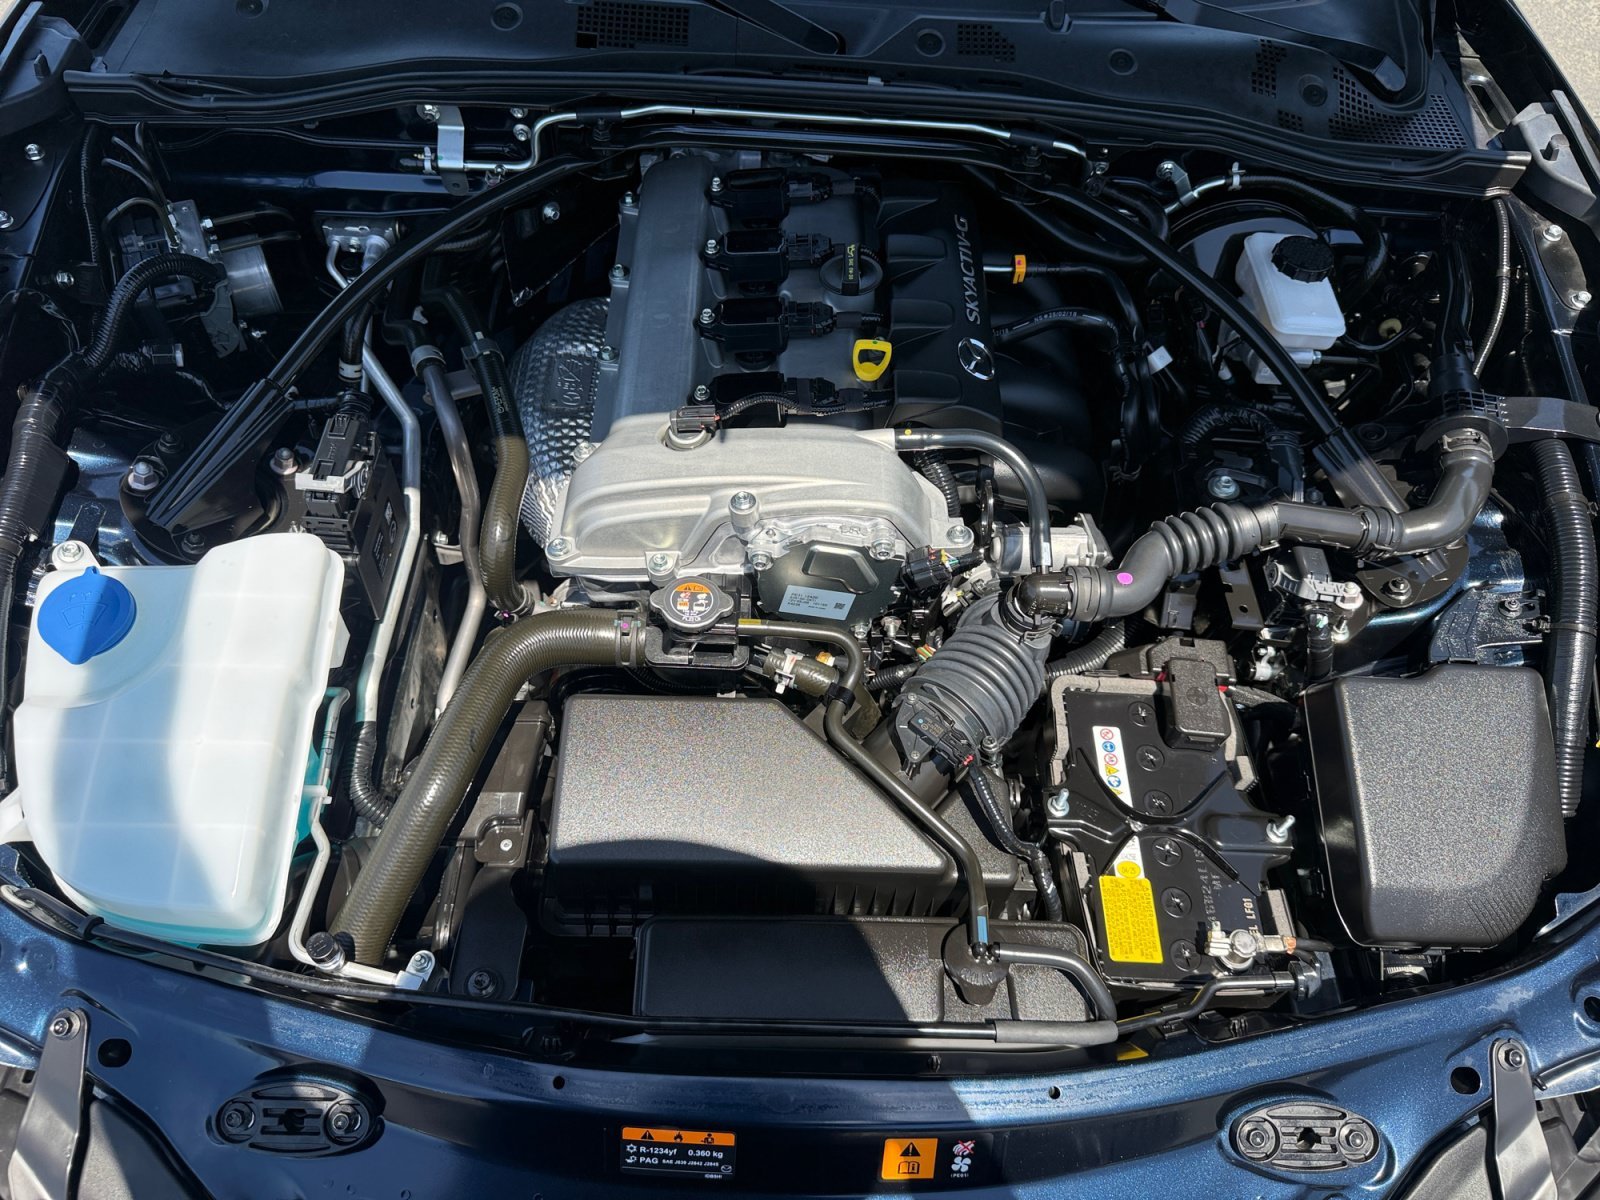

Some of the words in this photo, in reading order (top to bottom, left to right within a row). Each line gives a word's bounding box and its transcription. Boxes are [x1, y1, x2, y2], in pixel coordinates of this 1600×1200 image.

[954, 214, 981, 325] SKYACTIV-G
[639, 1146, 677, 1156] R-1234yf
[712, 1150, 724, 1159] kg
[639, 1156, 659, 1164] PAG
